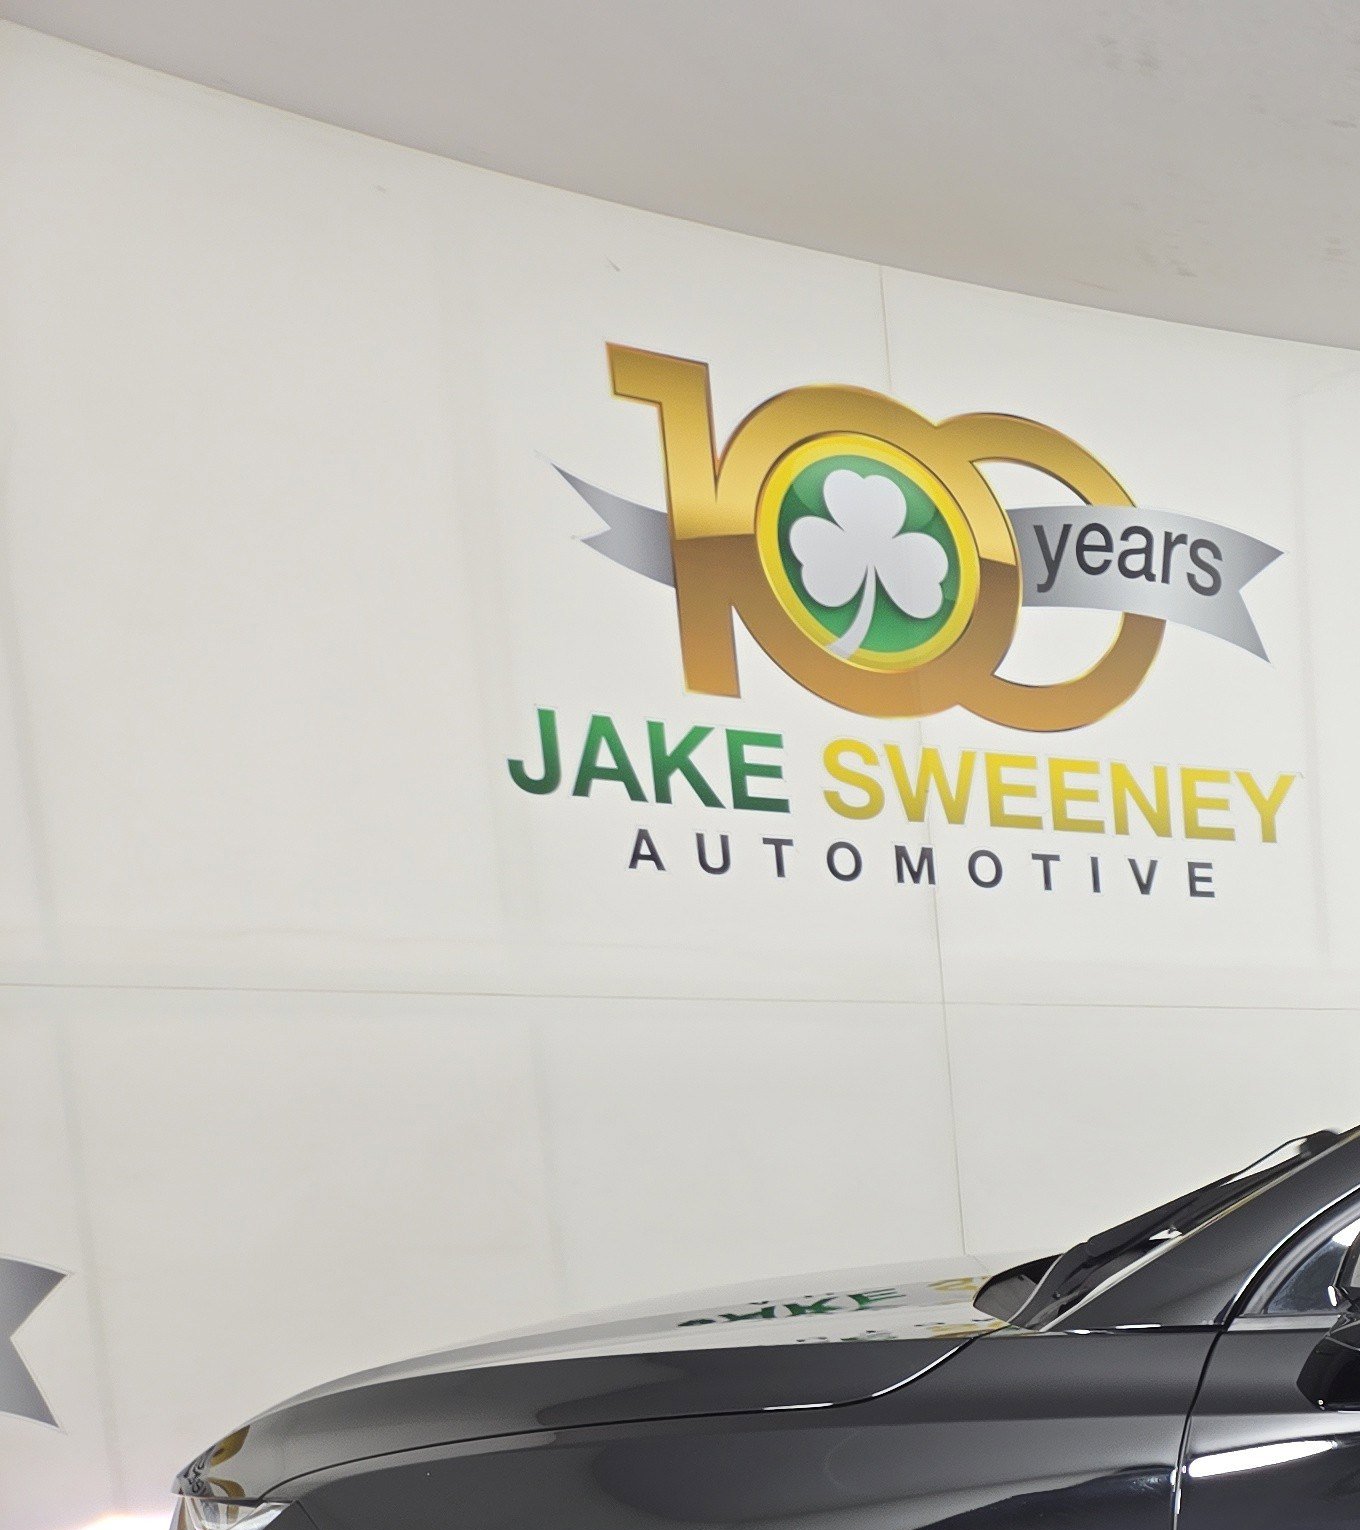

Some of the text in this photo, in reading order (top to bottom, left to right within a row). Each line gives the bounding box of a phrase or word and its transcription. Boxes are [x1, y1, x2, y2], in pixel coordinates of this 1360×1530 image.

[606, 342, 1166, 733] 100
[1033, 519, 1224, 598] years
[507, 708, 1298, 844] JAKE SWEENEY
[629, 829, 1216, 898] AUTOMOTIVE
